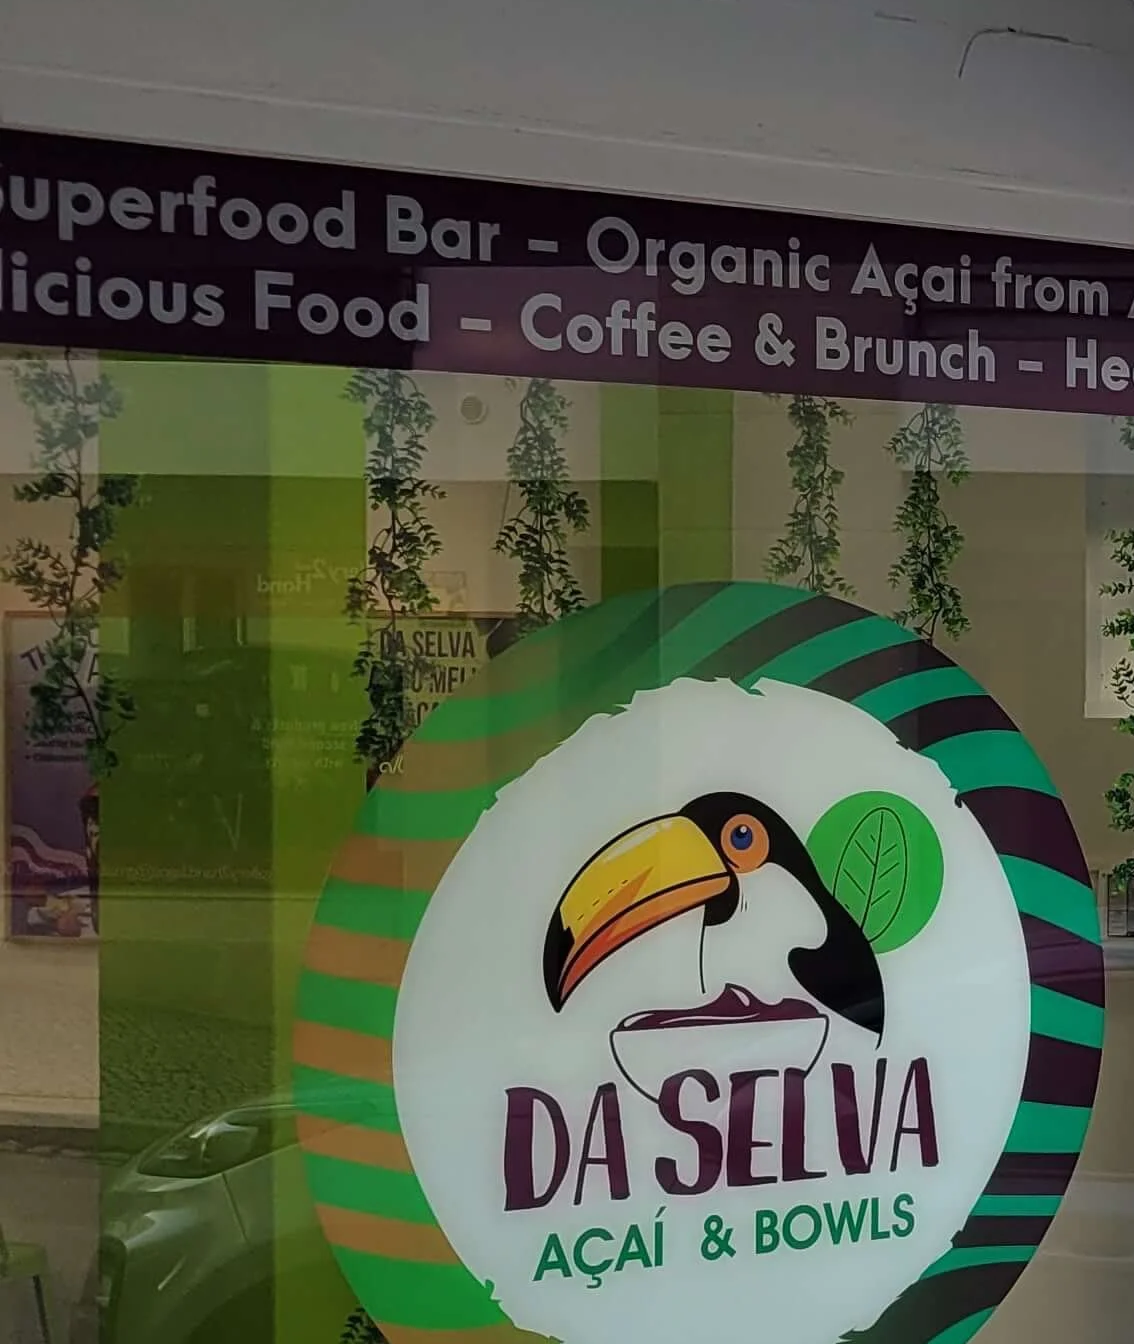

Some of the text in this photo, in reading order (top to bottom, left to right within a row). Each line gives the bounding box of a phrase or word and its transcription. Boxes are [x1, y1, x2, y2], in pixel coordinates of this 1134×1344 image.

[0, 173, 357, 250] uperfood
[386, 195, 501, 261] Bar
[587, 216, 830, 295] Organic
[851, 243, 972, 314] Açai
[992, 256, 1109, 318] from
[0, 248, 225, 327] icious
[254, 270, 431, 342] Food
[520, 292, 731, 364] Coffee
[755, 313, 796, 367] &
[815, 316, 996, 383] Brunch
[412, 630, 476, 658] SELVA
[503, 1056, 940, 1212] DA SELVA
[532, 1193, 916, 1289] AÇAÍ & BOWLS
